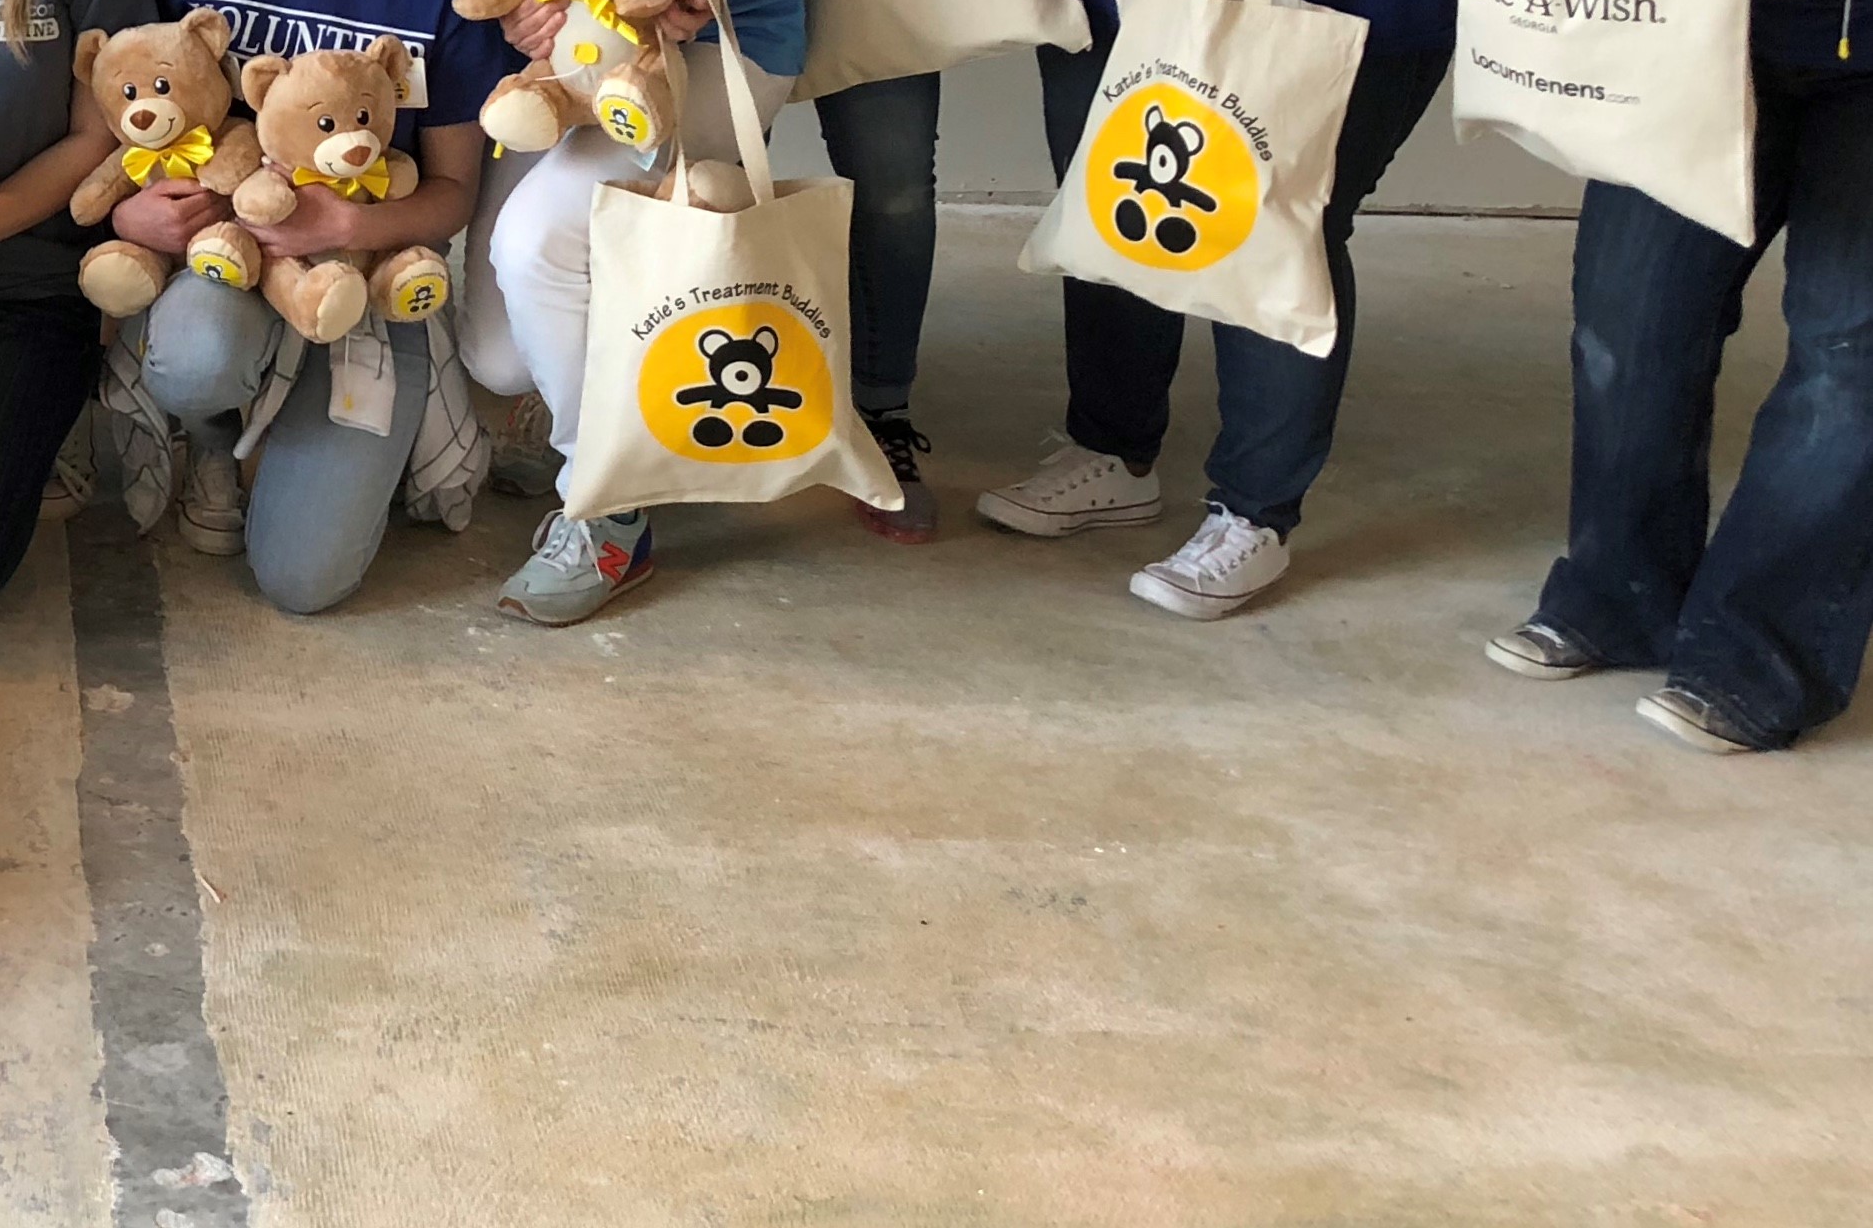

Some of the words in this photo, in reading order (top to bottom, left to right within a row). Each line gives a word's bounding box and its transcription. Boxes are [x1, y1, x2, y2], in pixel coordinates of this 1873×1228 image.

[1470, 47, 1641, 105] LocumTenens.com
[1102, 62, 1153, 103] Katie's
[1220, 92, 1274, 162] Buddies
[631, 295, 686, 341] Katie's
[689, 281, 780, 305] Treatment
[781, 283, 832, 339] Buddies
